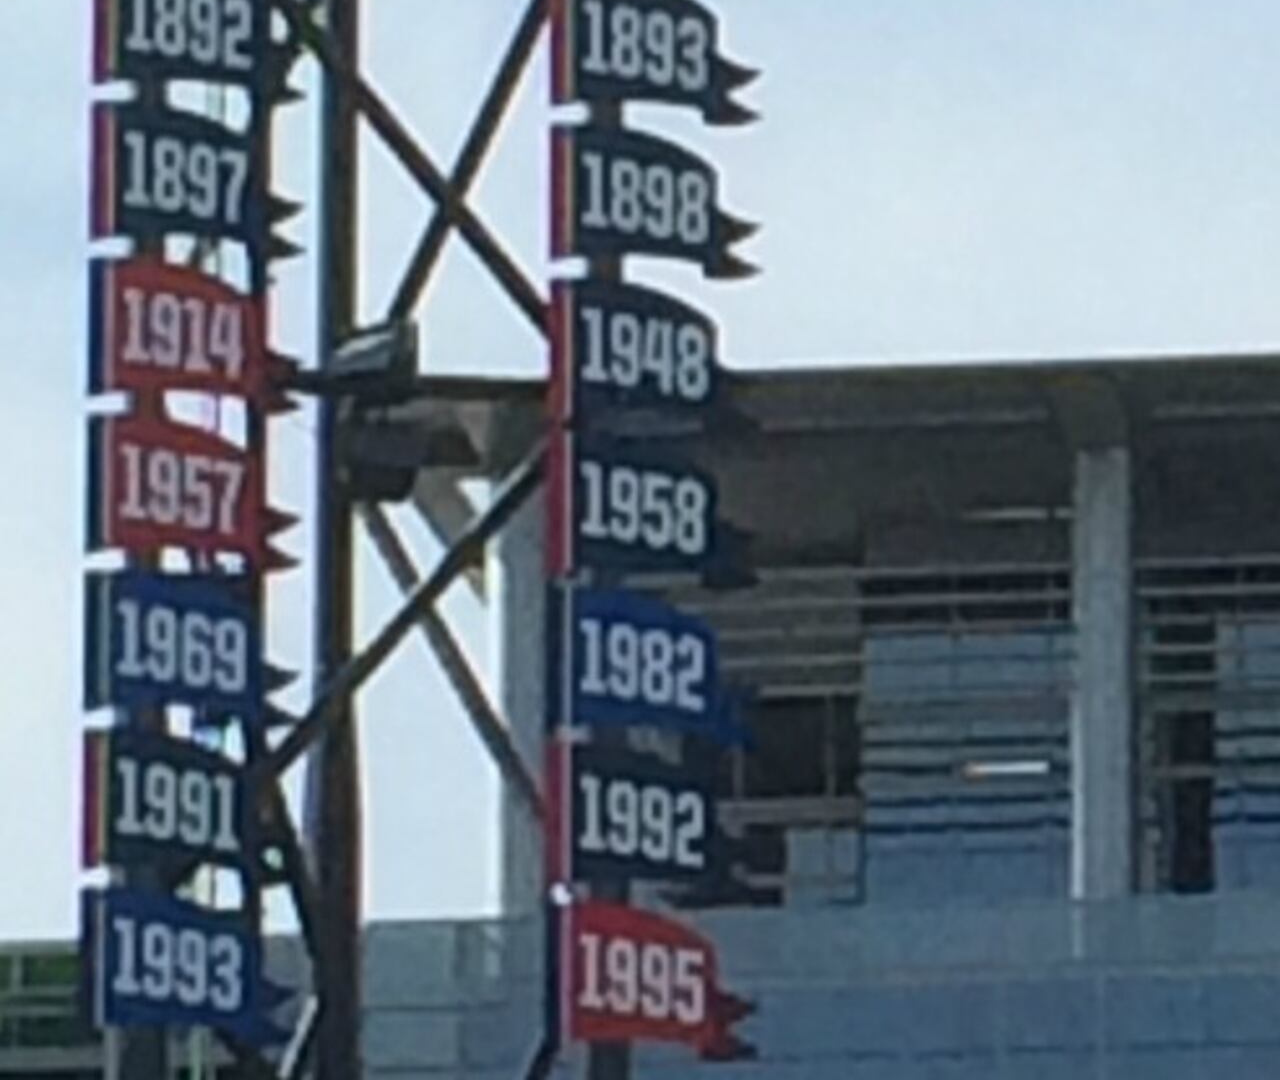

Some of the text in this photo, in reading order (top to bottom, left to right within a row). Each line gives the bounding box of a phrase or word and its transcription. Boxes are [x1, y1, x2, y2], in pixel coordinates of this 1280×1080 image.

[582, 0, 708, 89] 1893
[124, 132, 250, 225] 1897
[581, 153, 709, 243] 1898
[122, 288, 244, 374] 1914
[581, 308, 709, 399] 1948
[120, 444, 243, 533] 1957
[581, 462, 706, 552] 1958
[117, 600, 246, 691] 1969
[579, 619, 705, 709] 1982
[116, 759, 240, 851] 1991
[579, 775, 703, 868] 1992
[113, 919, 242, 1011] 1993
[579, 933, 704, 1020] 1995
